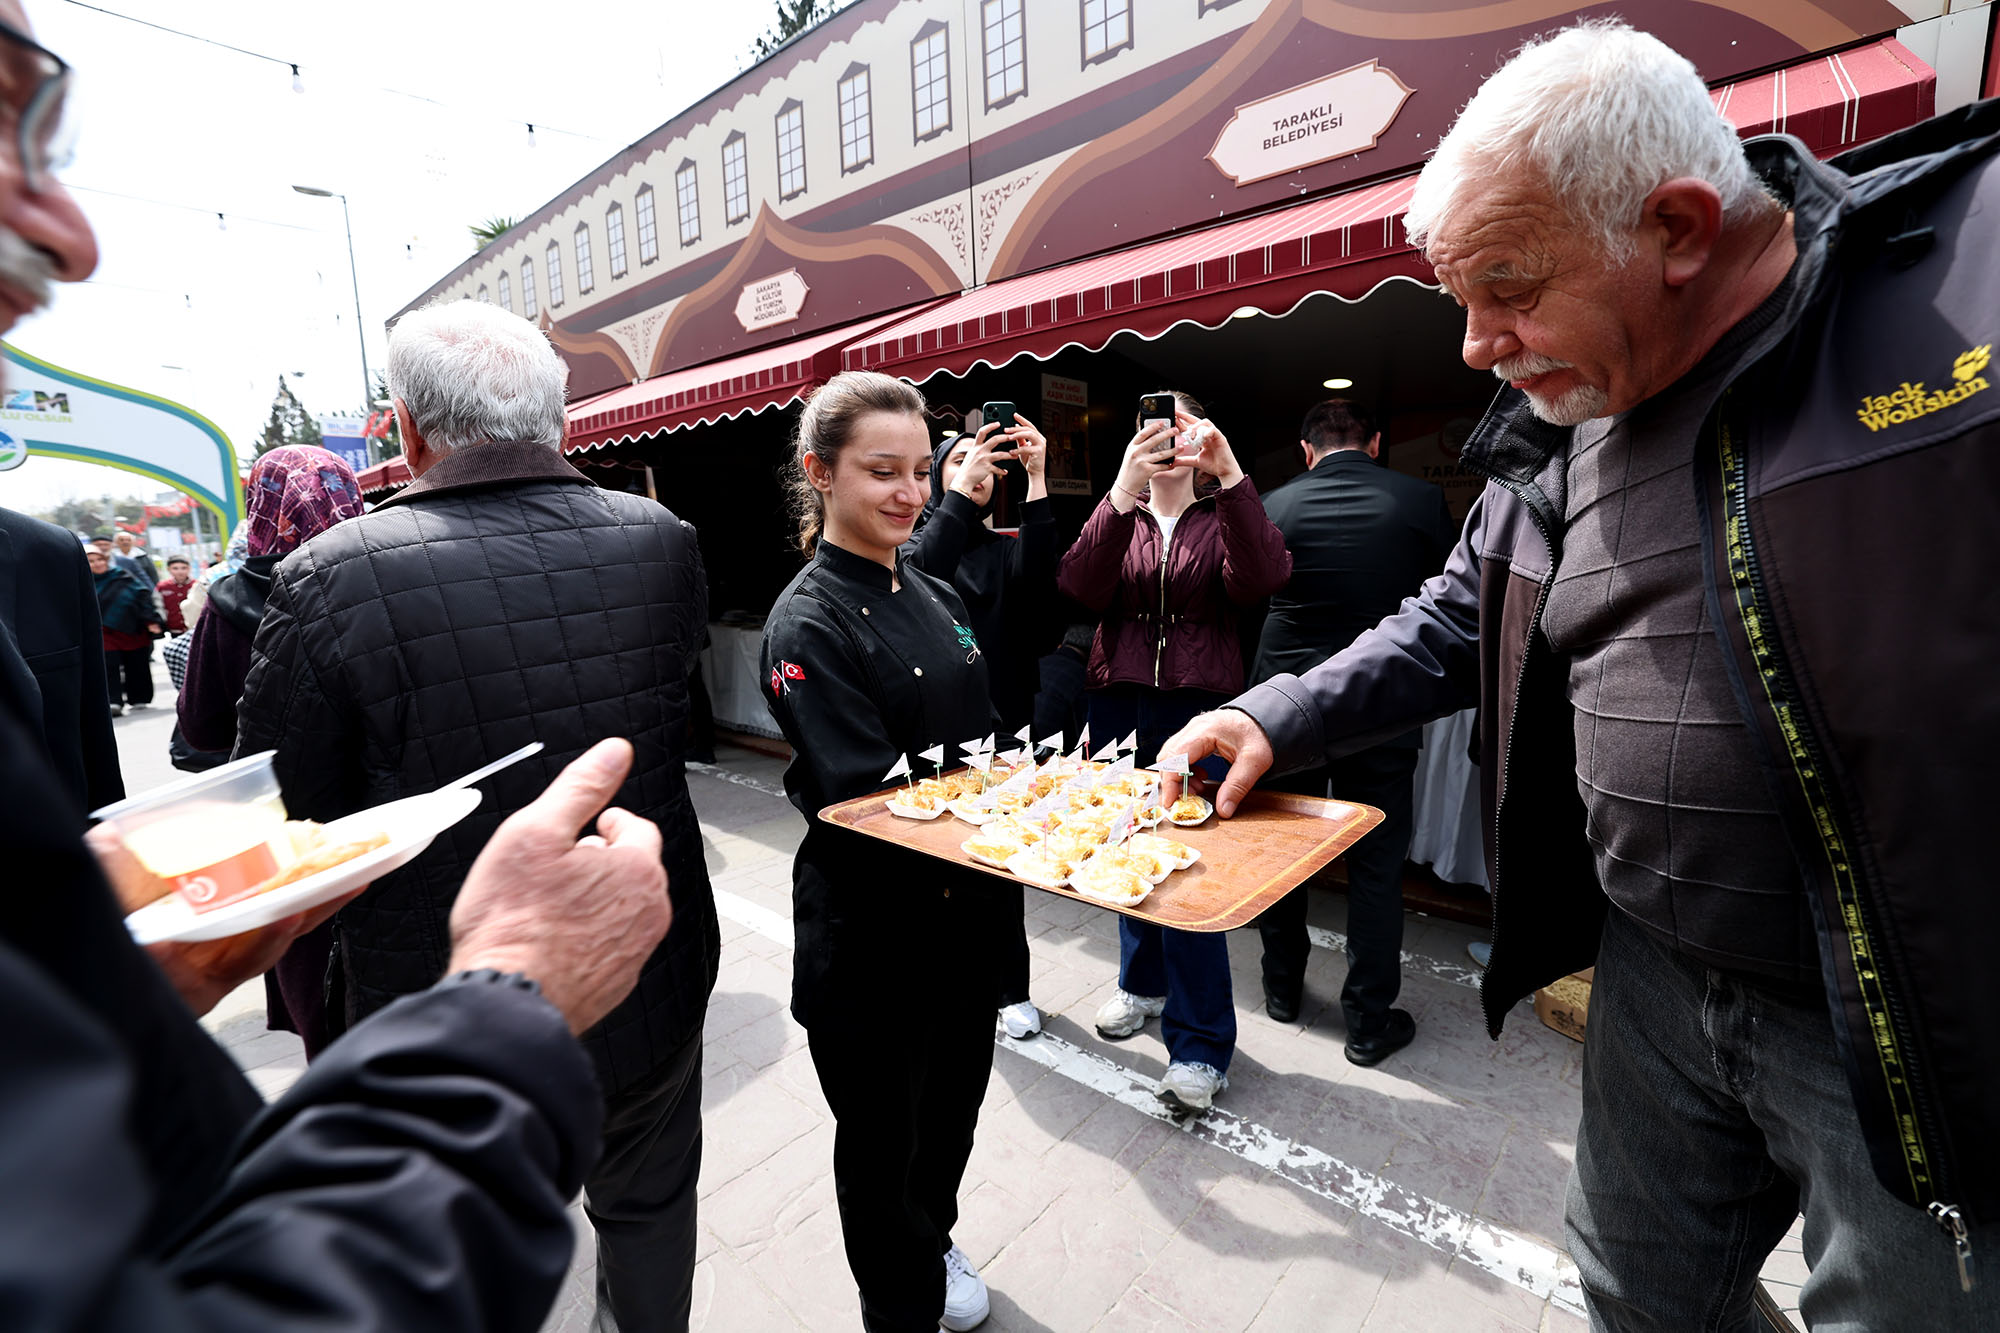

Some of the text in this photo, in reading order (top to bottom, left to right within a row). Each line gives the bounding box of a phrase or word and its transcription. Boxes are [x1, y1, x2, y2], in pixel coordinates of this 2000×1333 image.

[1262, 112, 1344, 151] BELEDİYESİ
[1272, 103, 1333, 132] TARAKLI
[756, 281, 780, 293] SAKARYA
[1856, 381, 1927, 416] Jack
[1858, 377, 1991, 432] Wolfskin
